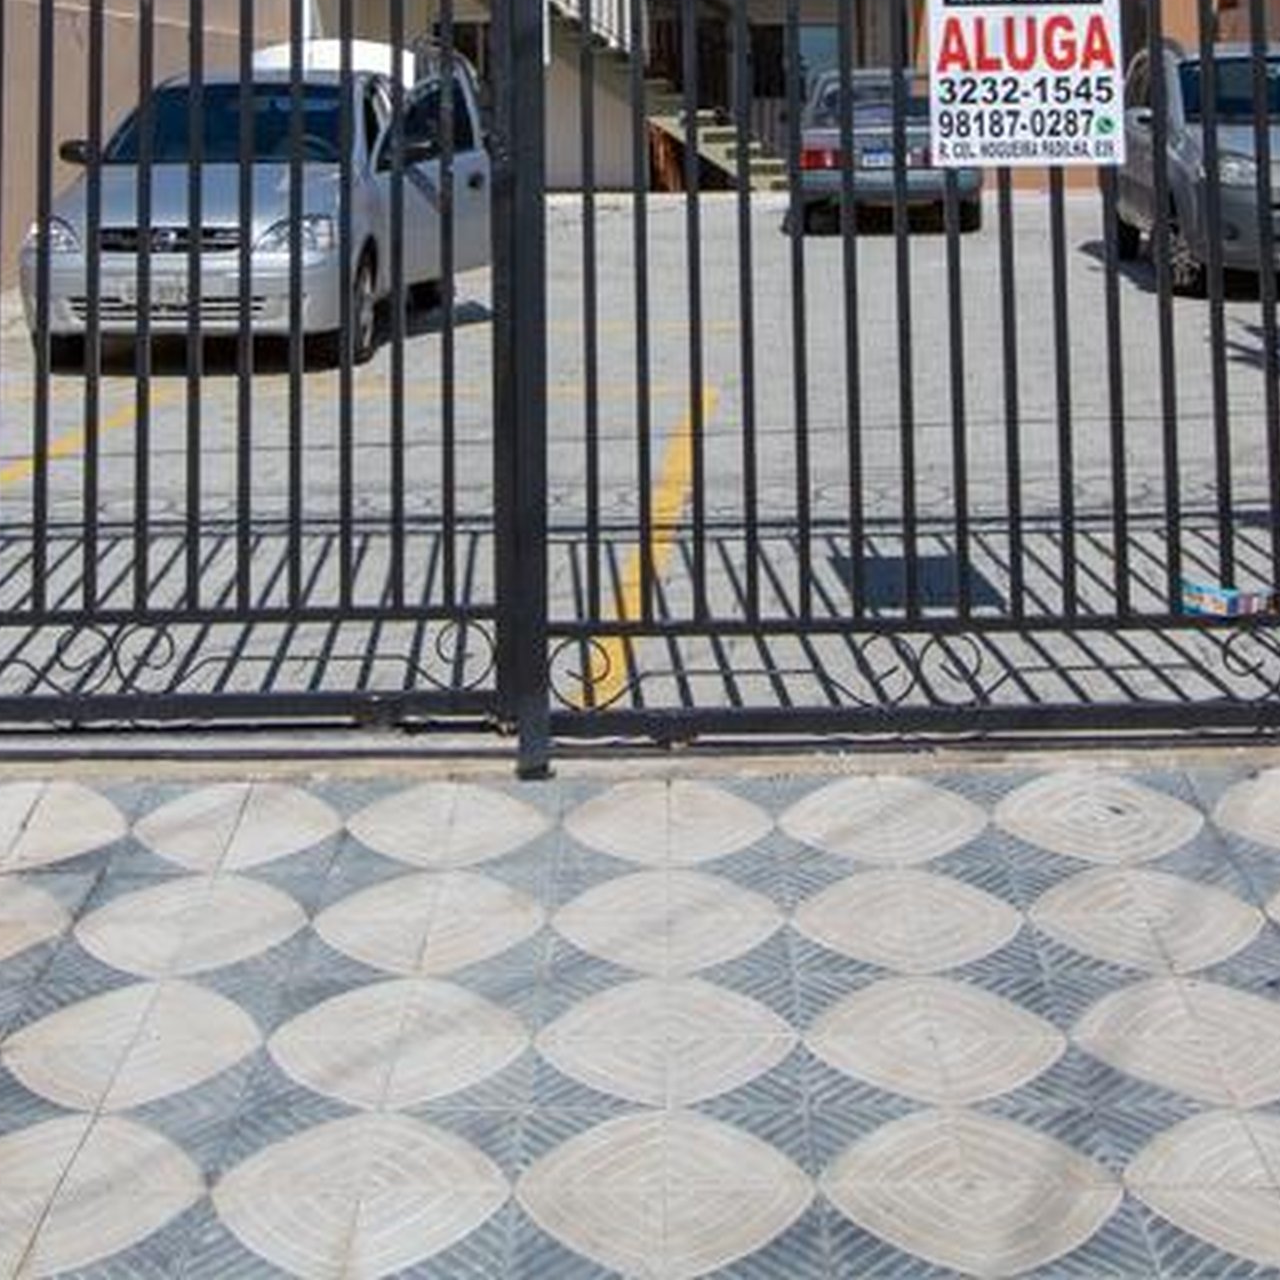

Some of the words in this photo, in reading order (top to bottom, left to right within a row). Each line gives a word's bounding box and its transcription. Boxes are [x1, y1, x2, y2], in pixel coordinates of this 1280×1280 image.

[937, 15, 1115, 72] ALUGA
[938, 77, 1114, 105] 3232-1545
[938, 109, 1095, 138] 98187-0287
